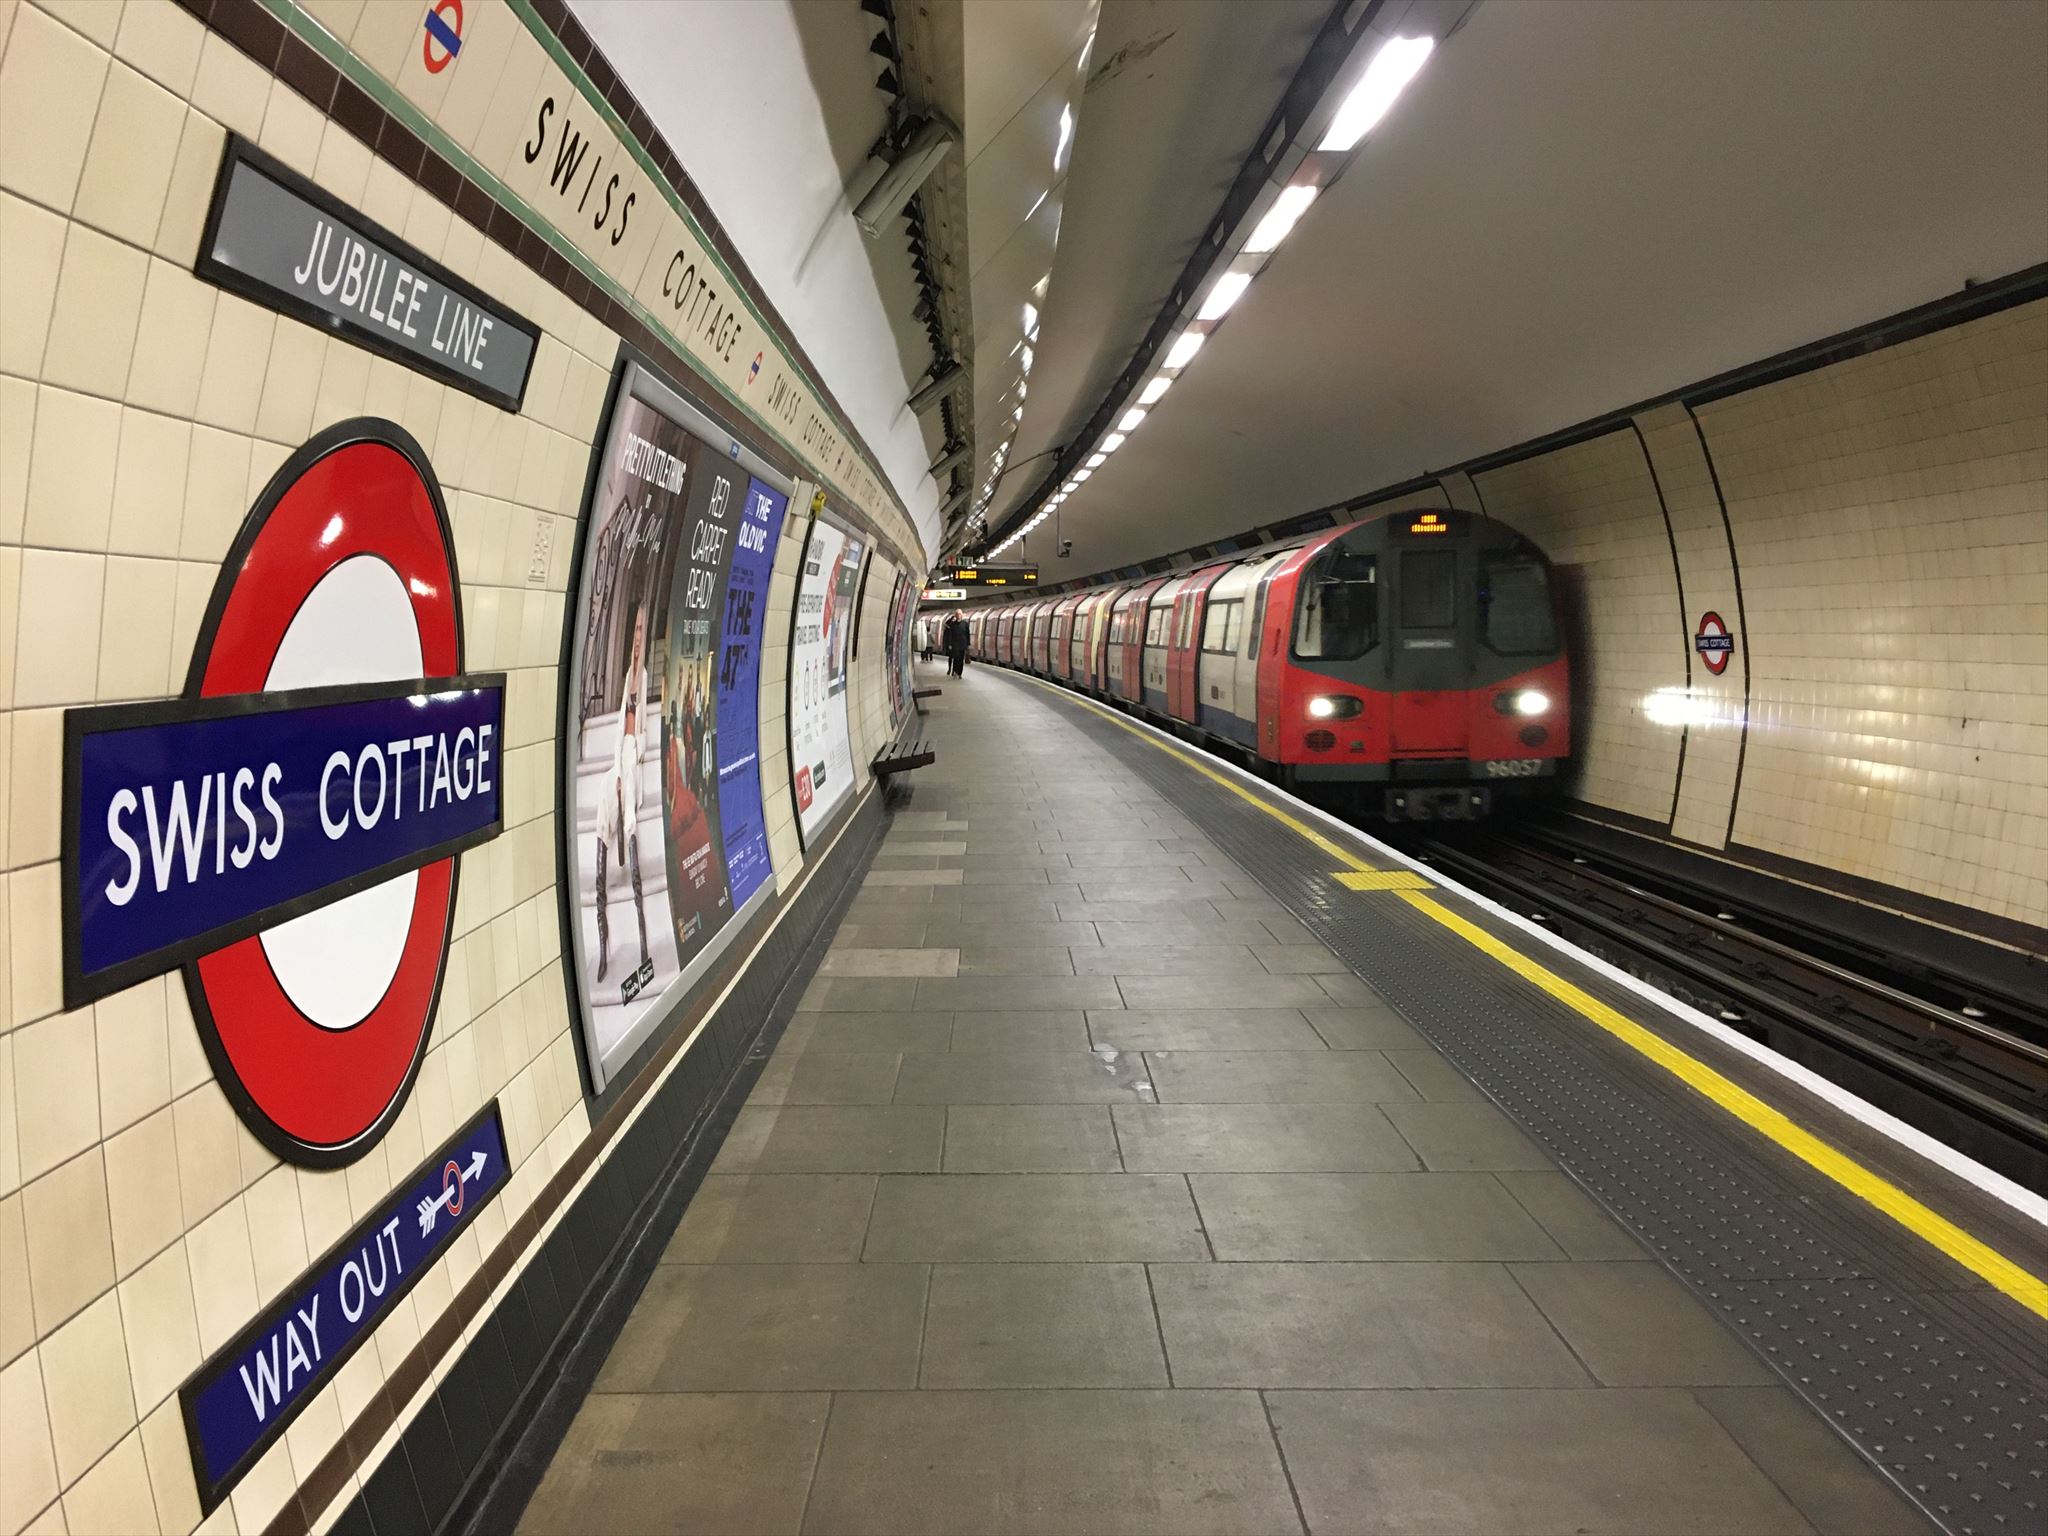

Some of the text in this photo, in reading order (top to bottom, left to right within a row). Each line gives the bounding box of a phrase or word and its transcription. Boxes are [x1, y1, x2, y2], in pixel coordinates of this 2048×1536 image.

[524, 97, 742, 363] SWISS COTTAGE
[294, 220, 493, 371] JUBILEE LINE
[768, 372, 836, 463] SWISS COTTAGE
[708, 475, 731, 519] RED
[755, 493, 773, 522] THE
[691, 519, 728, 565] CARPET
[685, 568, 717, 609] READY
[726, 588, 755, 636] THE
[1710, 638, 1731, 648] COTTAGE
[1487, 758, 1543, 778] 96057
[104, 724, 493, 907] SWISS COTTAGE
[239, 1216, 402, 1422] WAY OUT
